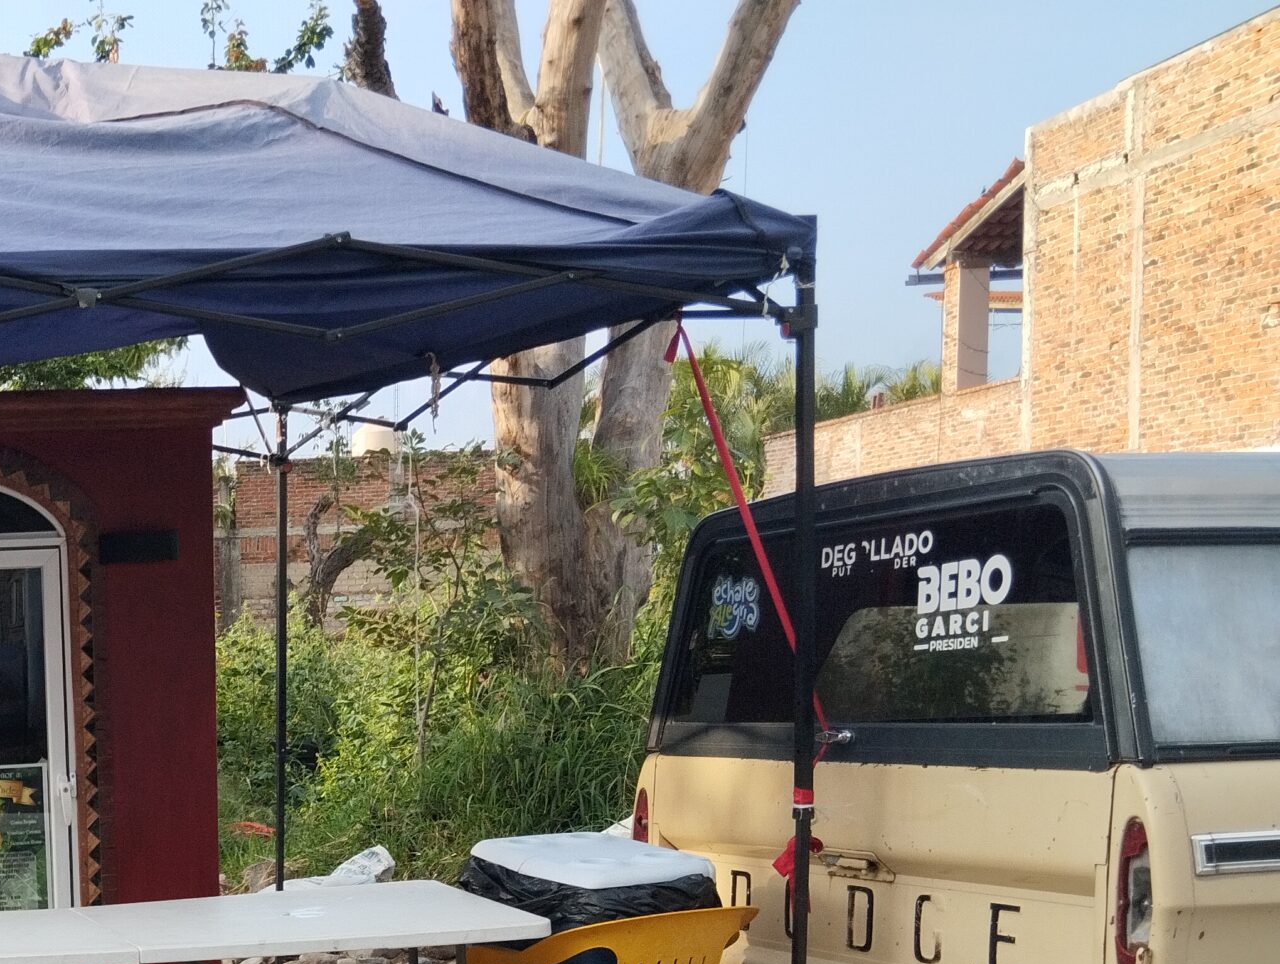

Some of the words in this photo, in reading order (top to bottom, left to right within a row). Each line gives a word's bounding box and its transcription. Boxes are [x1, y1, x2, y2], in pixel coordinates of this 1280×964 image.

[821, 530, 933, 569] DEGLLADO
[832, 565, 852, 578] PUT
[894, 556, 917, 569] DER
[917, 554, 1012, 615] BEBO
